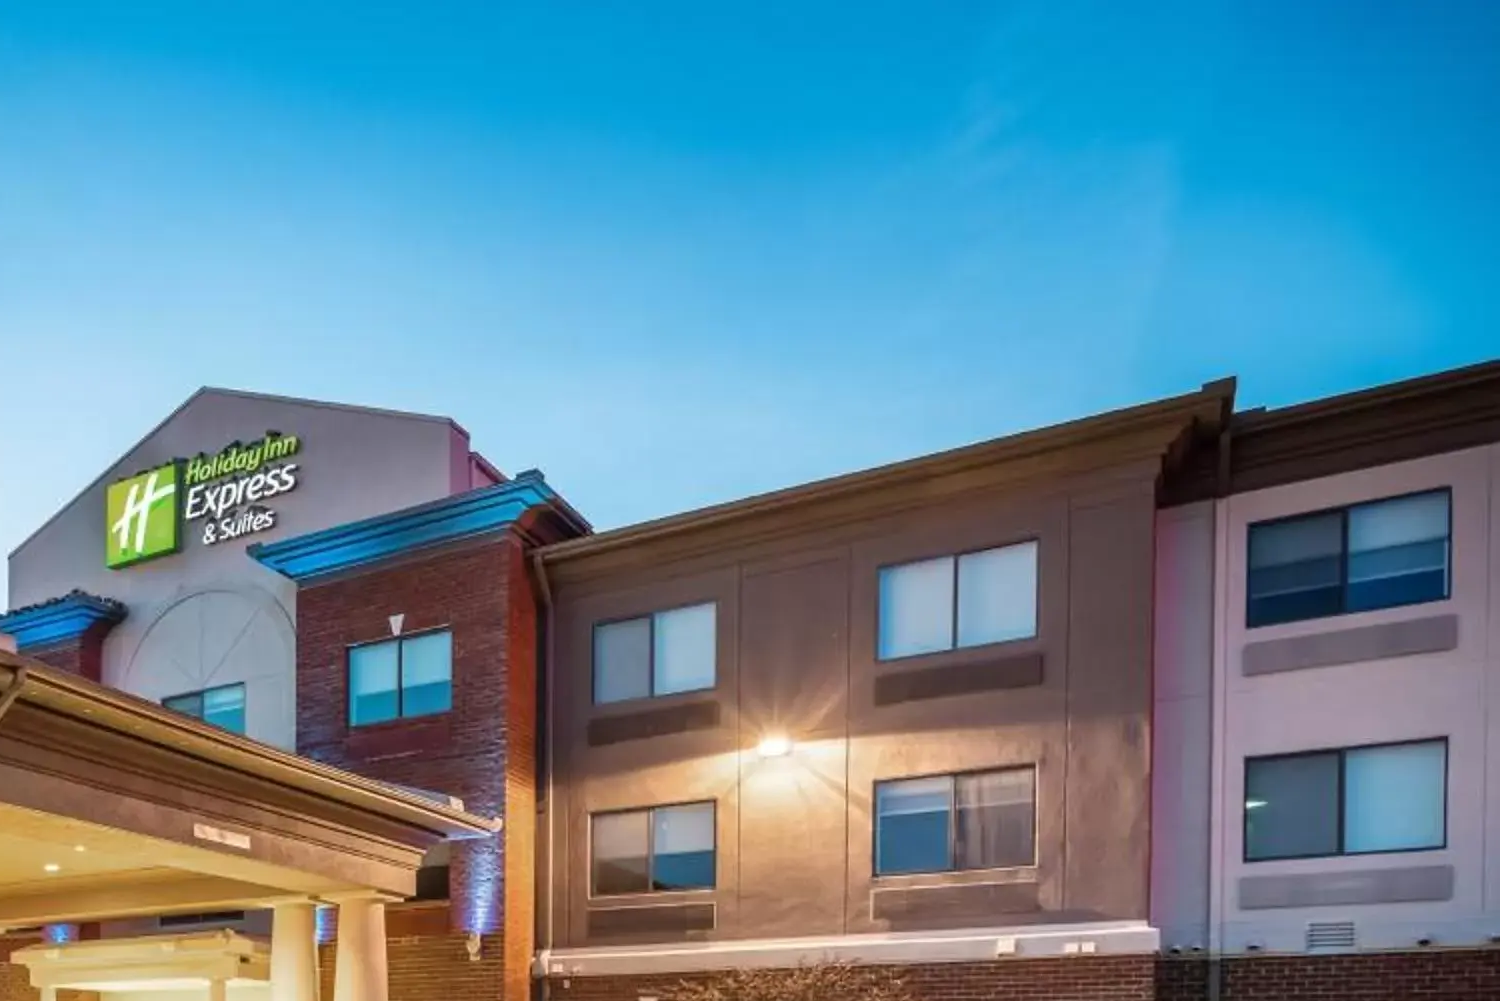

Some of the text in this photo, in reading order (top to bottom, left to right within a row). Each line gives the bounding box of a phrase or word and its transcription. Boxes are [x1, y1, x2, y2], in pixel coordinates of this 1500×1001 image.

[186, 436, 296, 482] Holiday Inn
[185, 463, 297, 519] Express
[202, 510, 275, 544] & Suites
